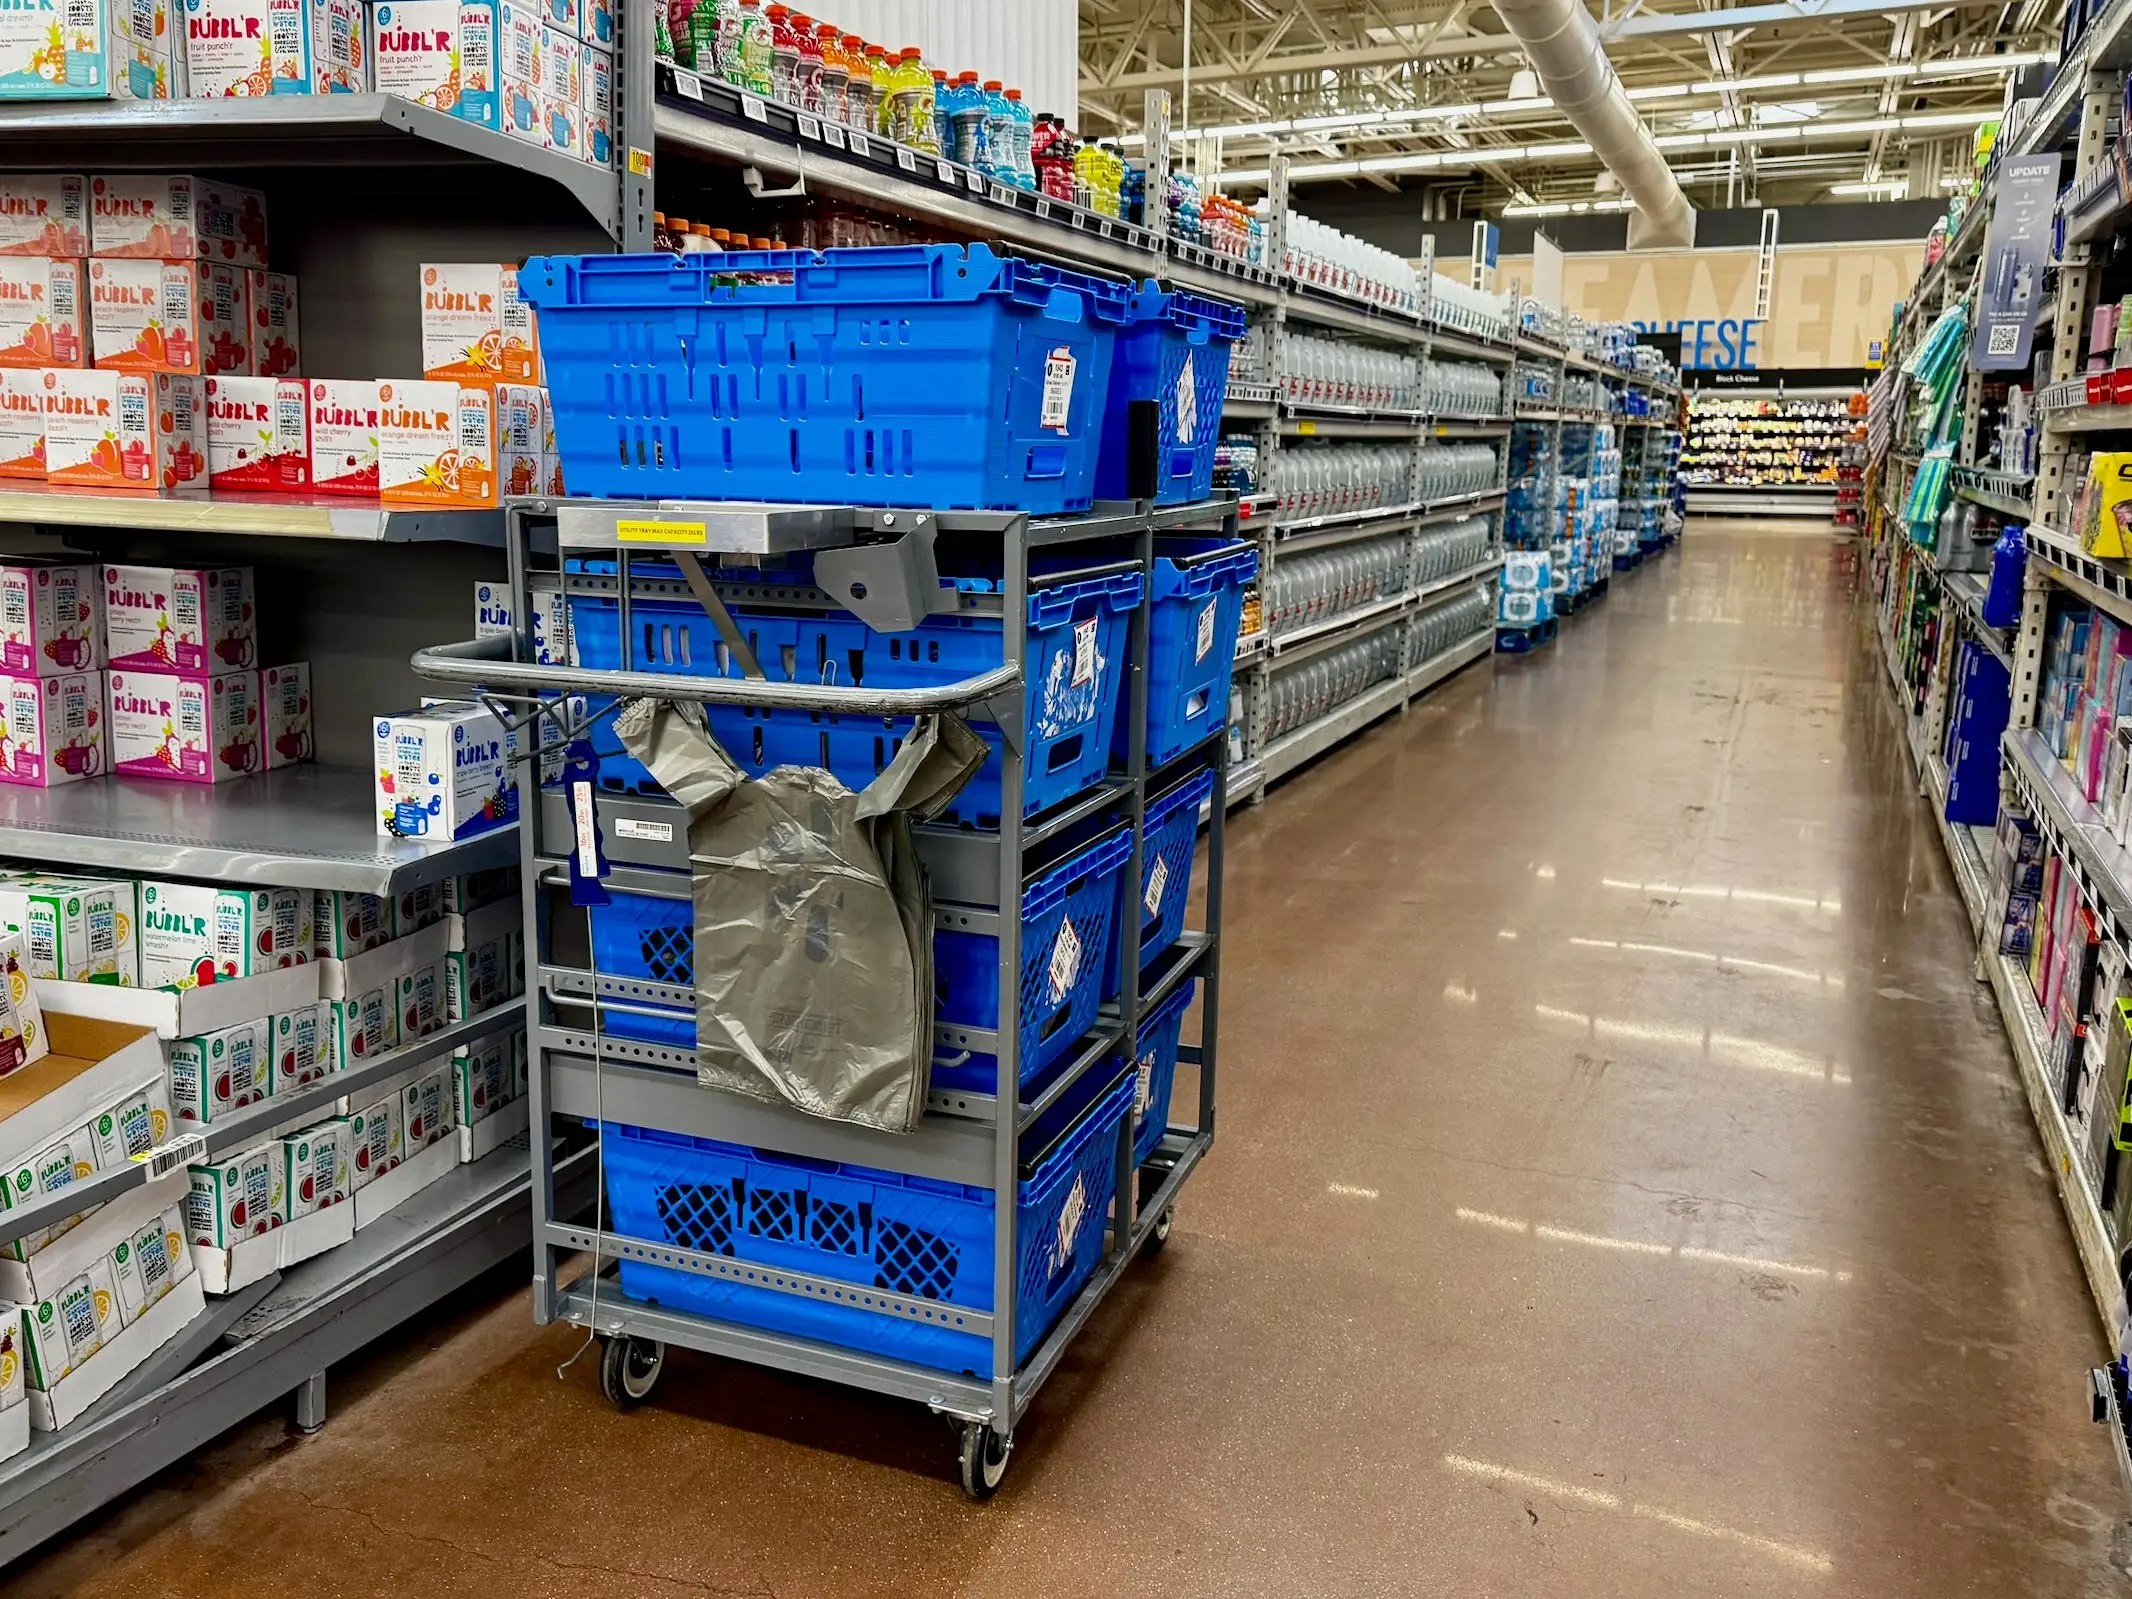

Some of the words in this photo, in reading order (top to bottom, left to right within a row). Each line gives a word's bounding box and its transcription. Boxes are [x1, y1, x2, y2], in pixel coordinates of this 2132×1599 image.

[190, 42, 205, 51] fruit
[207, 42, 233, 52] punch'r
[380, 56, 395, 64] fruit
[397, 56, 422, 64] punch'r
[2009, 165, 2051, 177] UPDATE
[1716, 374, 1734, 383] Block
[1735, 375, 1759, 383] Cheese
